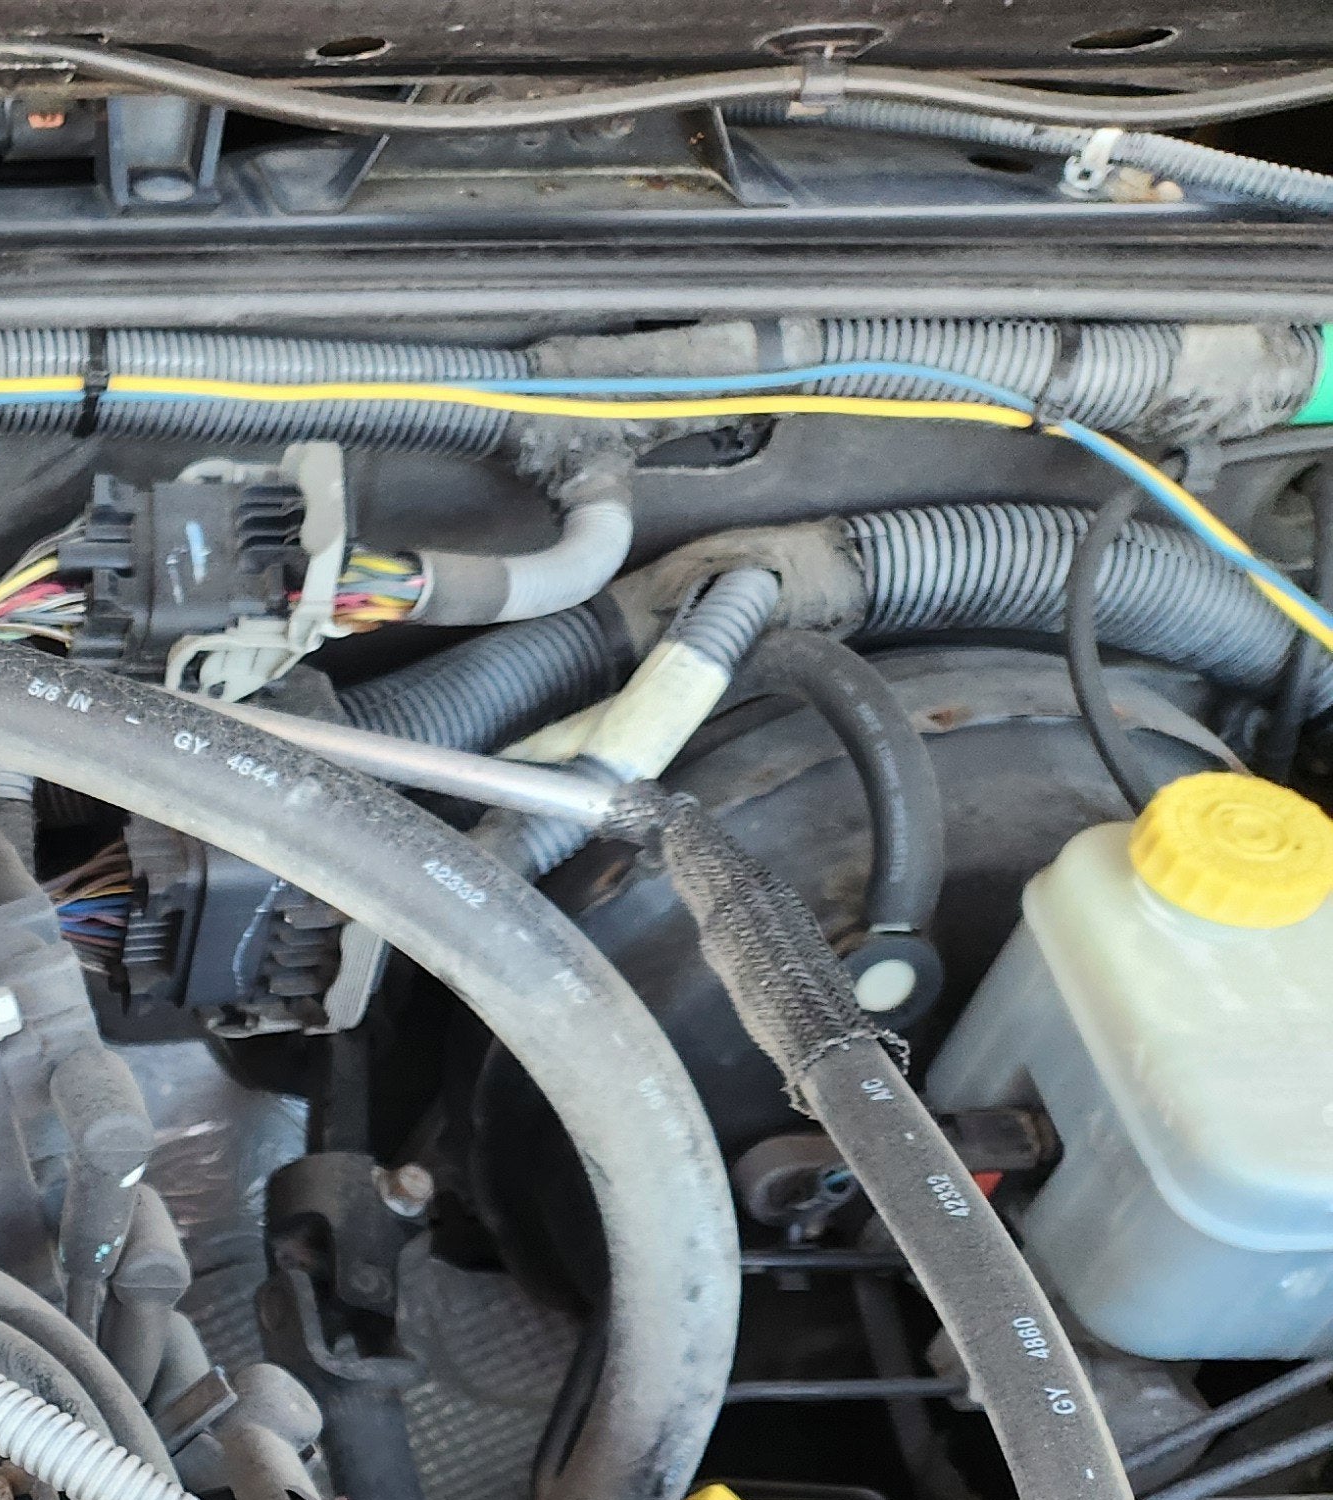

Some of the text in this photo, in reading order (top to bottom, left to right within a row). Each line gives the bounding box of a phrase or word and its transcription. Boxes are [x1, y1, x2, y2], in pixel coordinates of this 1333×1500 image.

[27, 677, 62, 702] 5/8
[66, 689, 94, 714] IN
[173, 730, 211, 755] GY
[226, 752, 279, 788] 4844
[926, 1173, 971, 1217] 42332
[1013, 1316, 1051, 1360] 4860
[1044, 1387, 1077, 1415] GY
